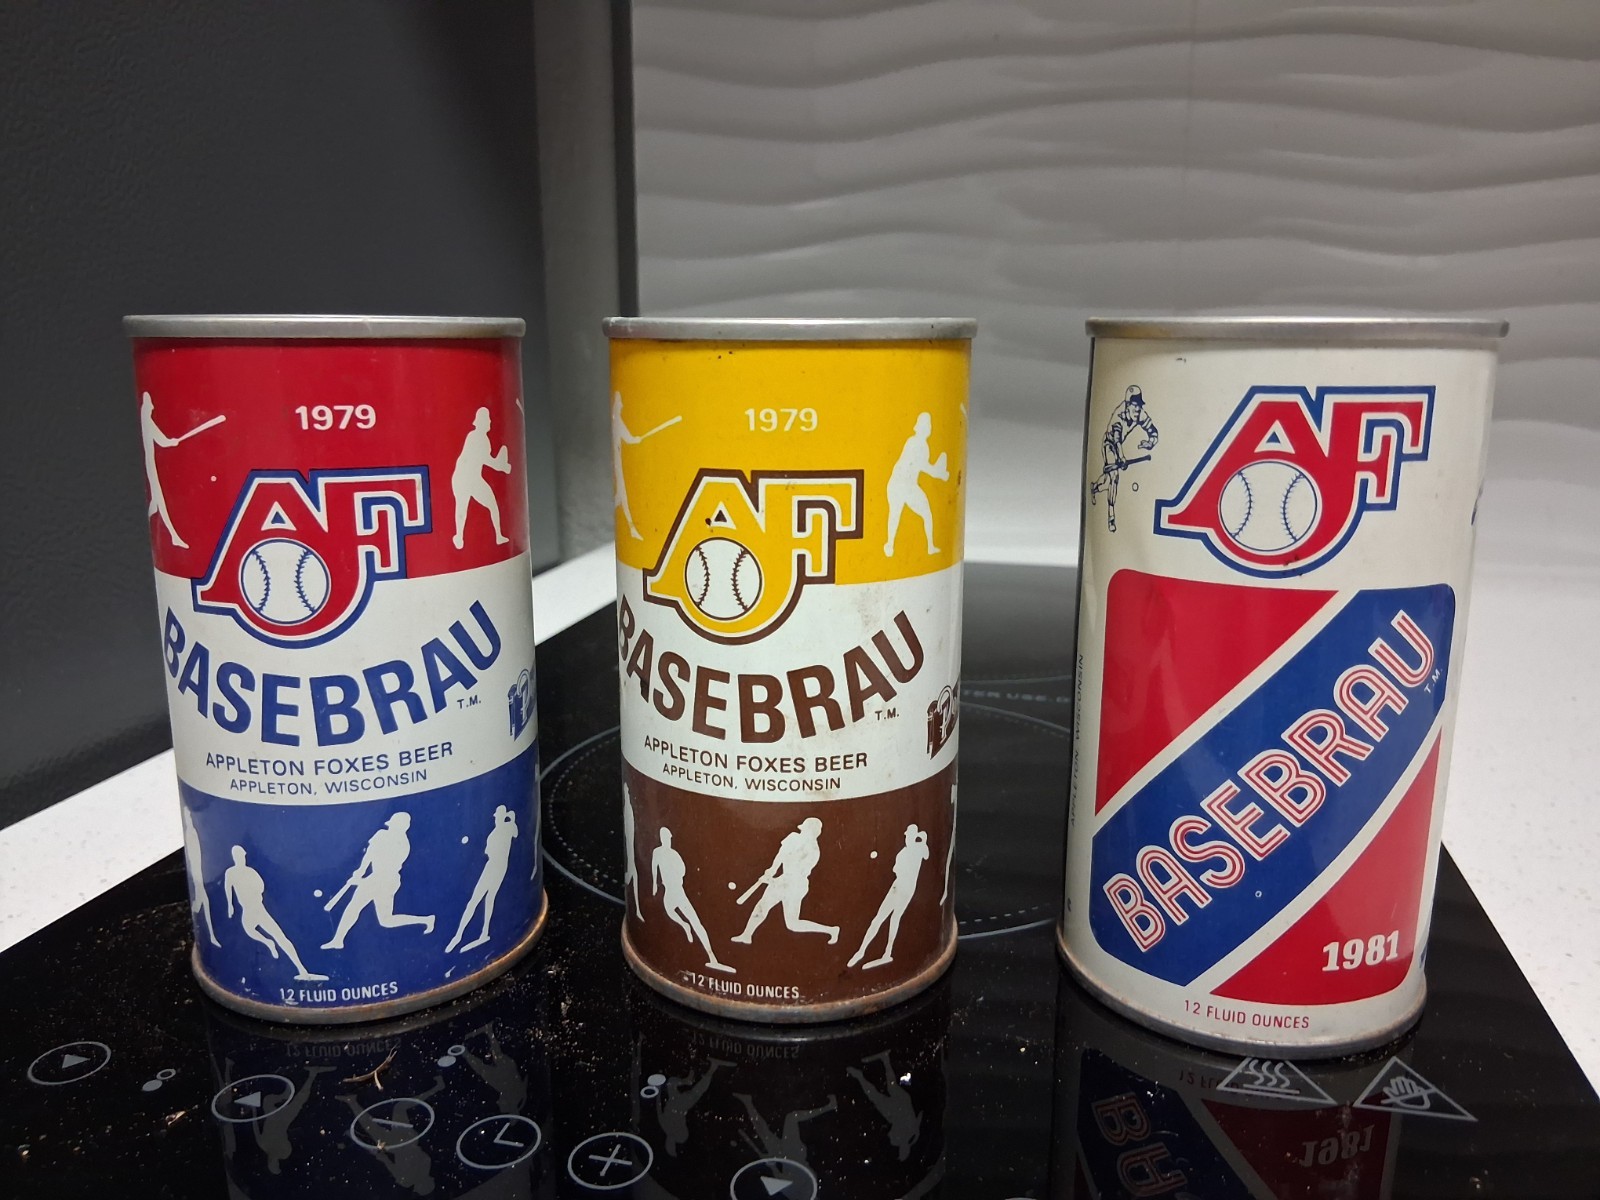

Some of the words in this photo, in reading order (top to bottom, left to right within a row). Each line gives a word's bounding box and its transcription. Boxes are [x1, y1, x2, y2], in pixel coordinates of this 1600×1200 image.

[295, 405, 376, 431] 1979
[744, 408, 818, 432] 1979
[164, 599, 501, 747] BASEBRAU
[618, 594, 924, 743] BASEBRAU
[1074, 654, 1084, 741] WISCONSIN
[206, 752, 304, 776] APPLETON
[314, 754, 389, 776] FOXES
[398, 741, 453, 766] BEER
[644, 735, 728, 769] APPLETON
[736, 755, 806, 773] FOXES
[815, 752, 868, 772] BEER
[230, 778, 317, 796] APPLETON,
[325, 769, 428, 794] WISCONSIN
[662, 763, 738, 790] APPLETON,
[744, 776, 842, 792] WISCONSIN
[1103, 609, 1435, 953] BASEBRAU
[1321, 930, 1400, 973] 1981
[280, 987, 295, 1001] 12
[299, 987, 337, 1002] FLUID
[341, 982, 399, 1000] OUNCES
[691, 972, 705, 987] 12
[708, 978, 742, 995] FLUID
[746, 984, 800, 999] OUNCES
[1184, 1000, 1201, 1015] 12
[1206, 1005, 1246, 1025] FLUID
[1252, 1013, 1310, 1029] OUNCES
